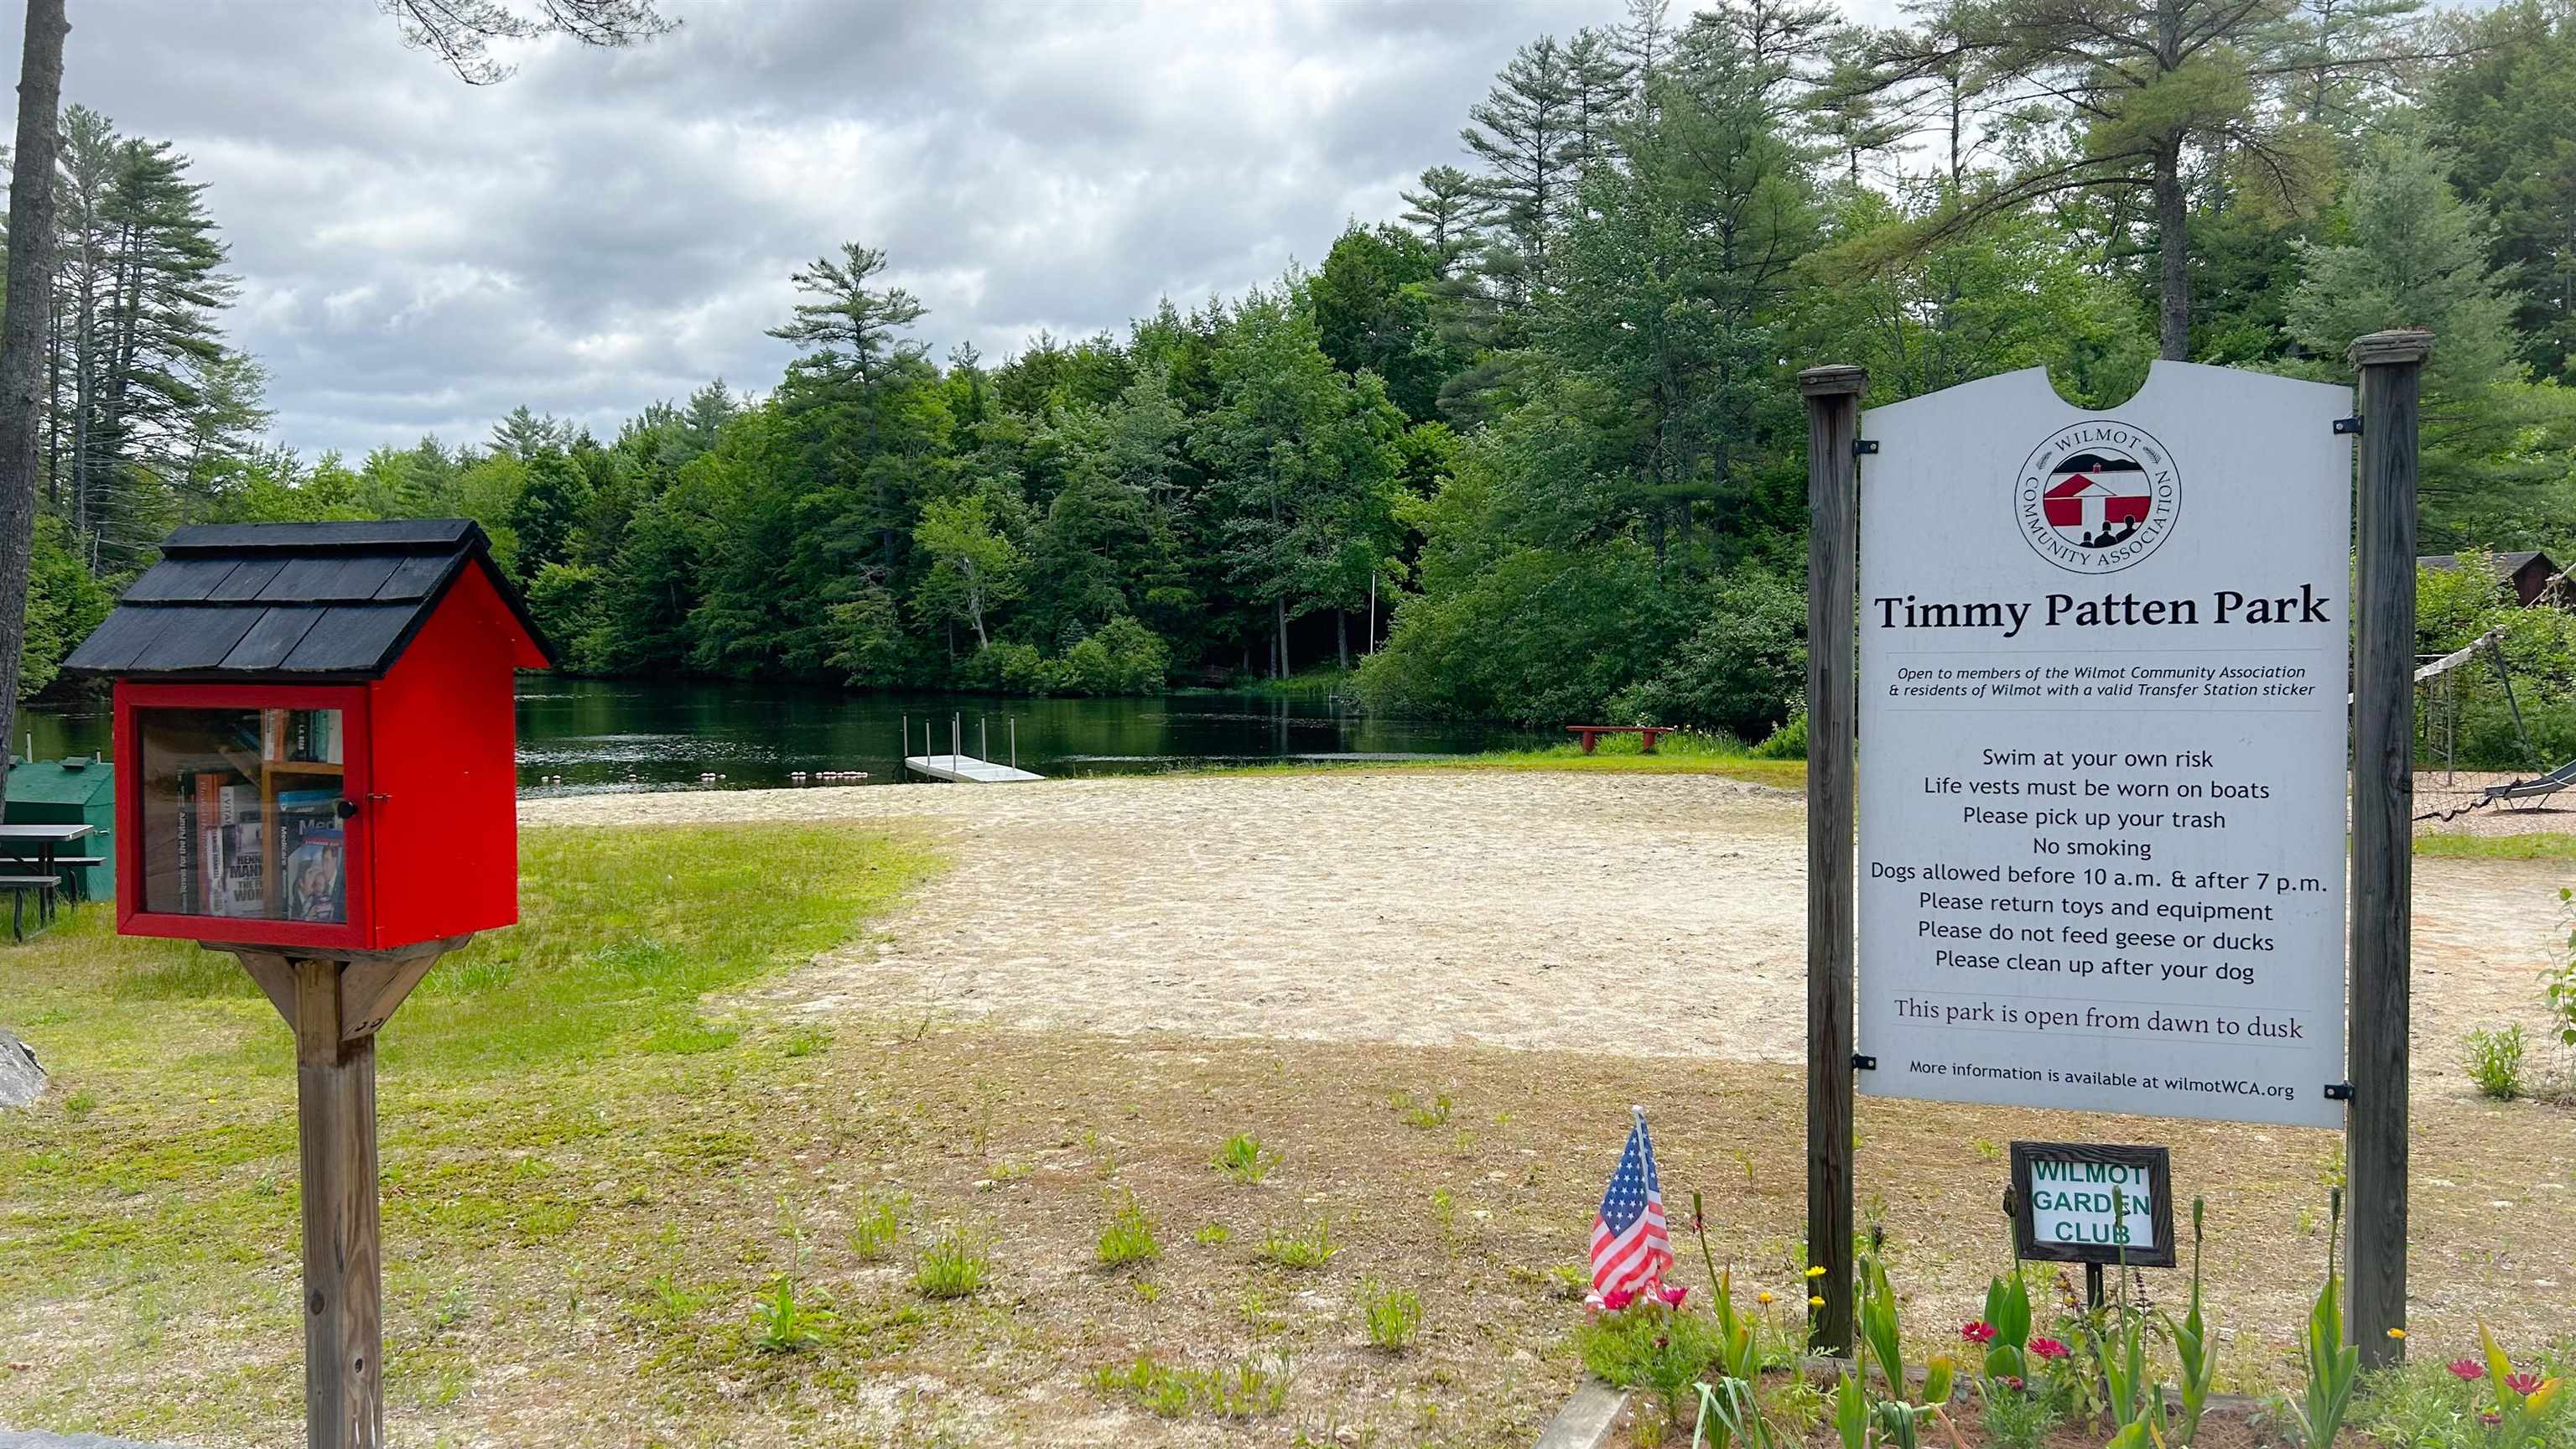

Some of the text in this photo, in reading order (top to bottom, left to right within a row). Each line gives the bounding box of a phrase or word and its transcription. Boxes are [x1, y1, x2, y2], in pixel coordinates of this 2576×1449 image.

[2054, 428, 2142, 451] WILMOT
[2023, 470, 2173, 566] COMMUNITY ASSOCIATION
[1873, 583, 2331, 638] Timmy Patten Park
[1898, 665, 2306, 683] Open to members of the Wilmot Community Association
[1888, 683, 2317, 699] & residents of Wilmot with a valid Transfer Station sticker
[1982, 748, 2214, 771] Swim at your own risk
[1924, 776, 2270, 799] Life vests must be worn on boats
[177, 811, 186, 839] Future
[1963, 806, 2225, 831] Please pick up your trash
[178, 840, 186, 854] the
[2033, 837, 2152, 861] No smoking
[179, 854, 187, 868] for
[179, 868, 188, 893] Tennis
[1871, 861, 2327, 896] Dogs allowed before 10 a.m. & after 7 p.m.
[1919, 891, 2274, 923] Please return toys and equipment
[1919, 920, 2274, 952] Please do not feed geese or ducks
[1935, 949, 2255, 985] Please clean up after your dog
[1893, 997, 2303, 1039] This park is open from dawn to dusk
[1909, 1060, 2295, 1101] More information is available at wilmotWCA.org
[2034, 1161, 2146, 1185] WILMOT
[2055, 1221, 2131, 1244] CLUB
